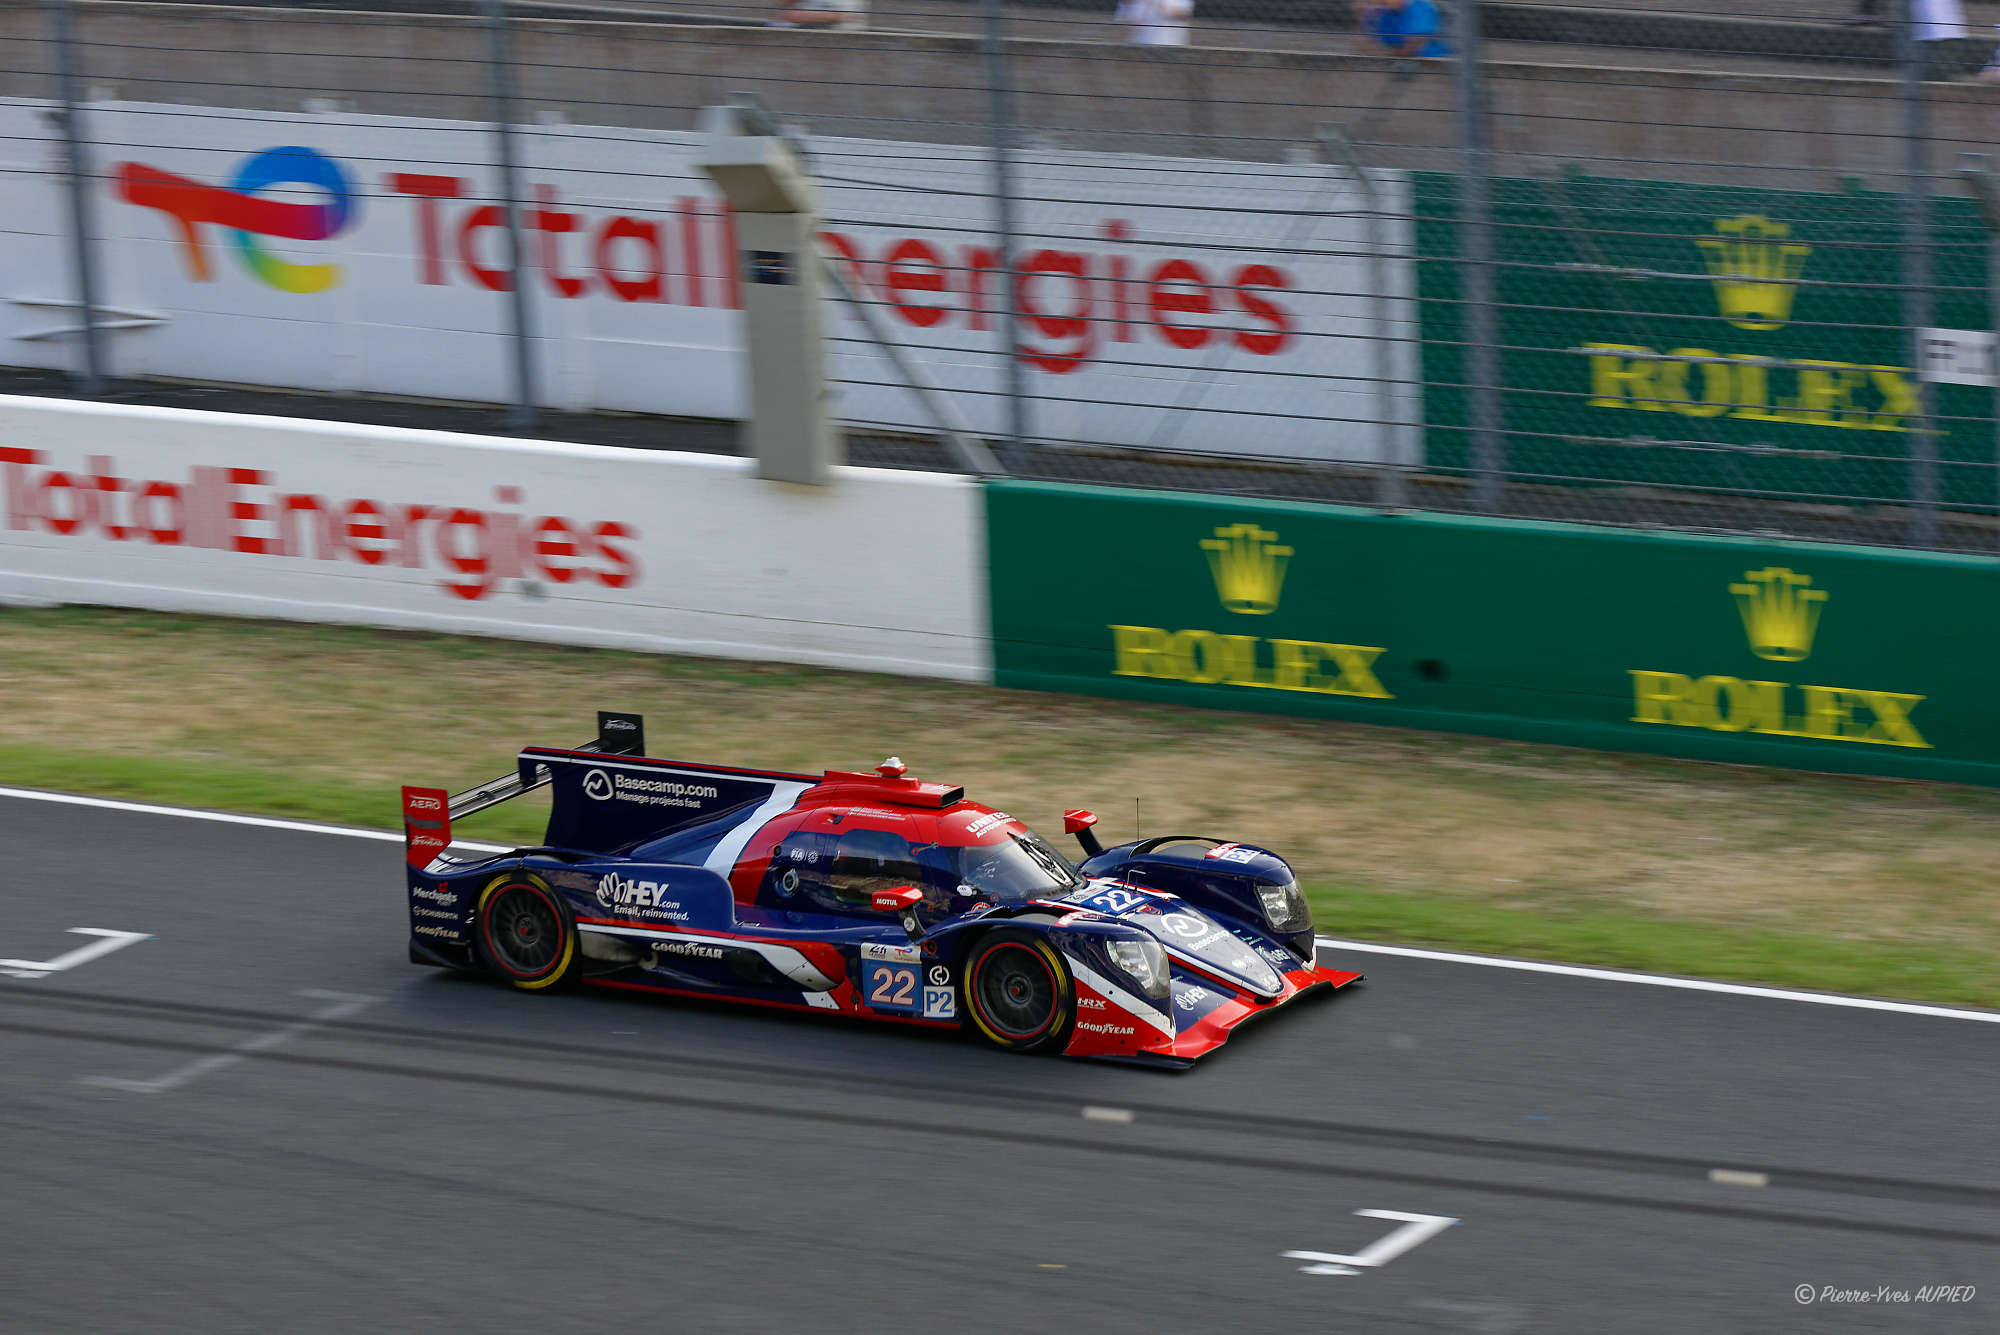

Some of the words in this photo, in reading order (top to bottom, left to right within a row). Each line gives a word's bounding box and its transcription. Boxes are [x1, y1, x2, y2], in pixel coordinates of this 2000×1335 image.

[385, 172, 1296, 373] Totalergies
[1581, 342, 1948, 434] ROLEX
[0, 446, 638, 600] TotalEnergies
[1108, 625, 1395, 700] ROLEX
[1627, 669, 1934, 748] ROLEX
[614, 774, 718, 799] Basecamp.com
[409, 800, 441, 810] AERO
[615, 790, 650, 804] Manage
[650, 795, 684, 807] projects
[684, 798, 701, 808] fast
[614, 904, 640, 918] Email,
[641, 908, 690, 920] reinvented.
[876, 898, 898, 906] MOTUL
[1092, 889, 1145, 912] 22
[651, 942, 723, 959] GOODYEAR
[871, 967, 916, 1006] 22
[925, 990, 953, 1013] P2
[1077, 1021, 1135, 1035] GOODYEAR
